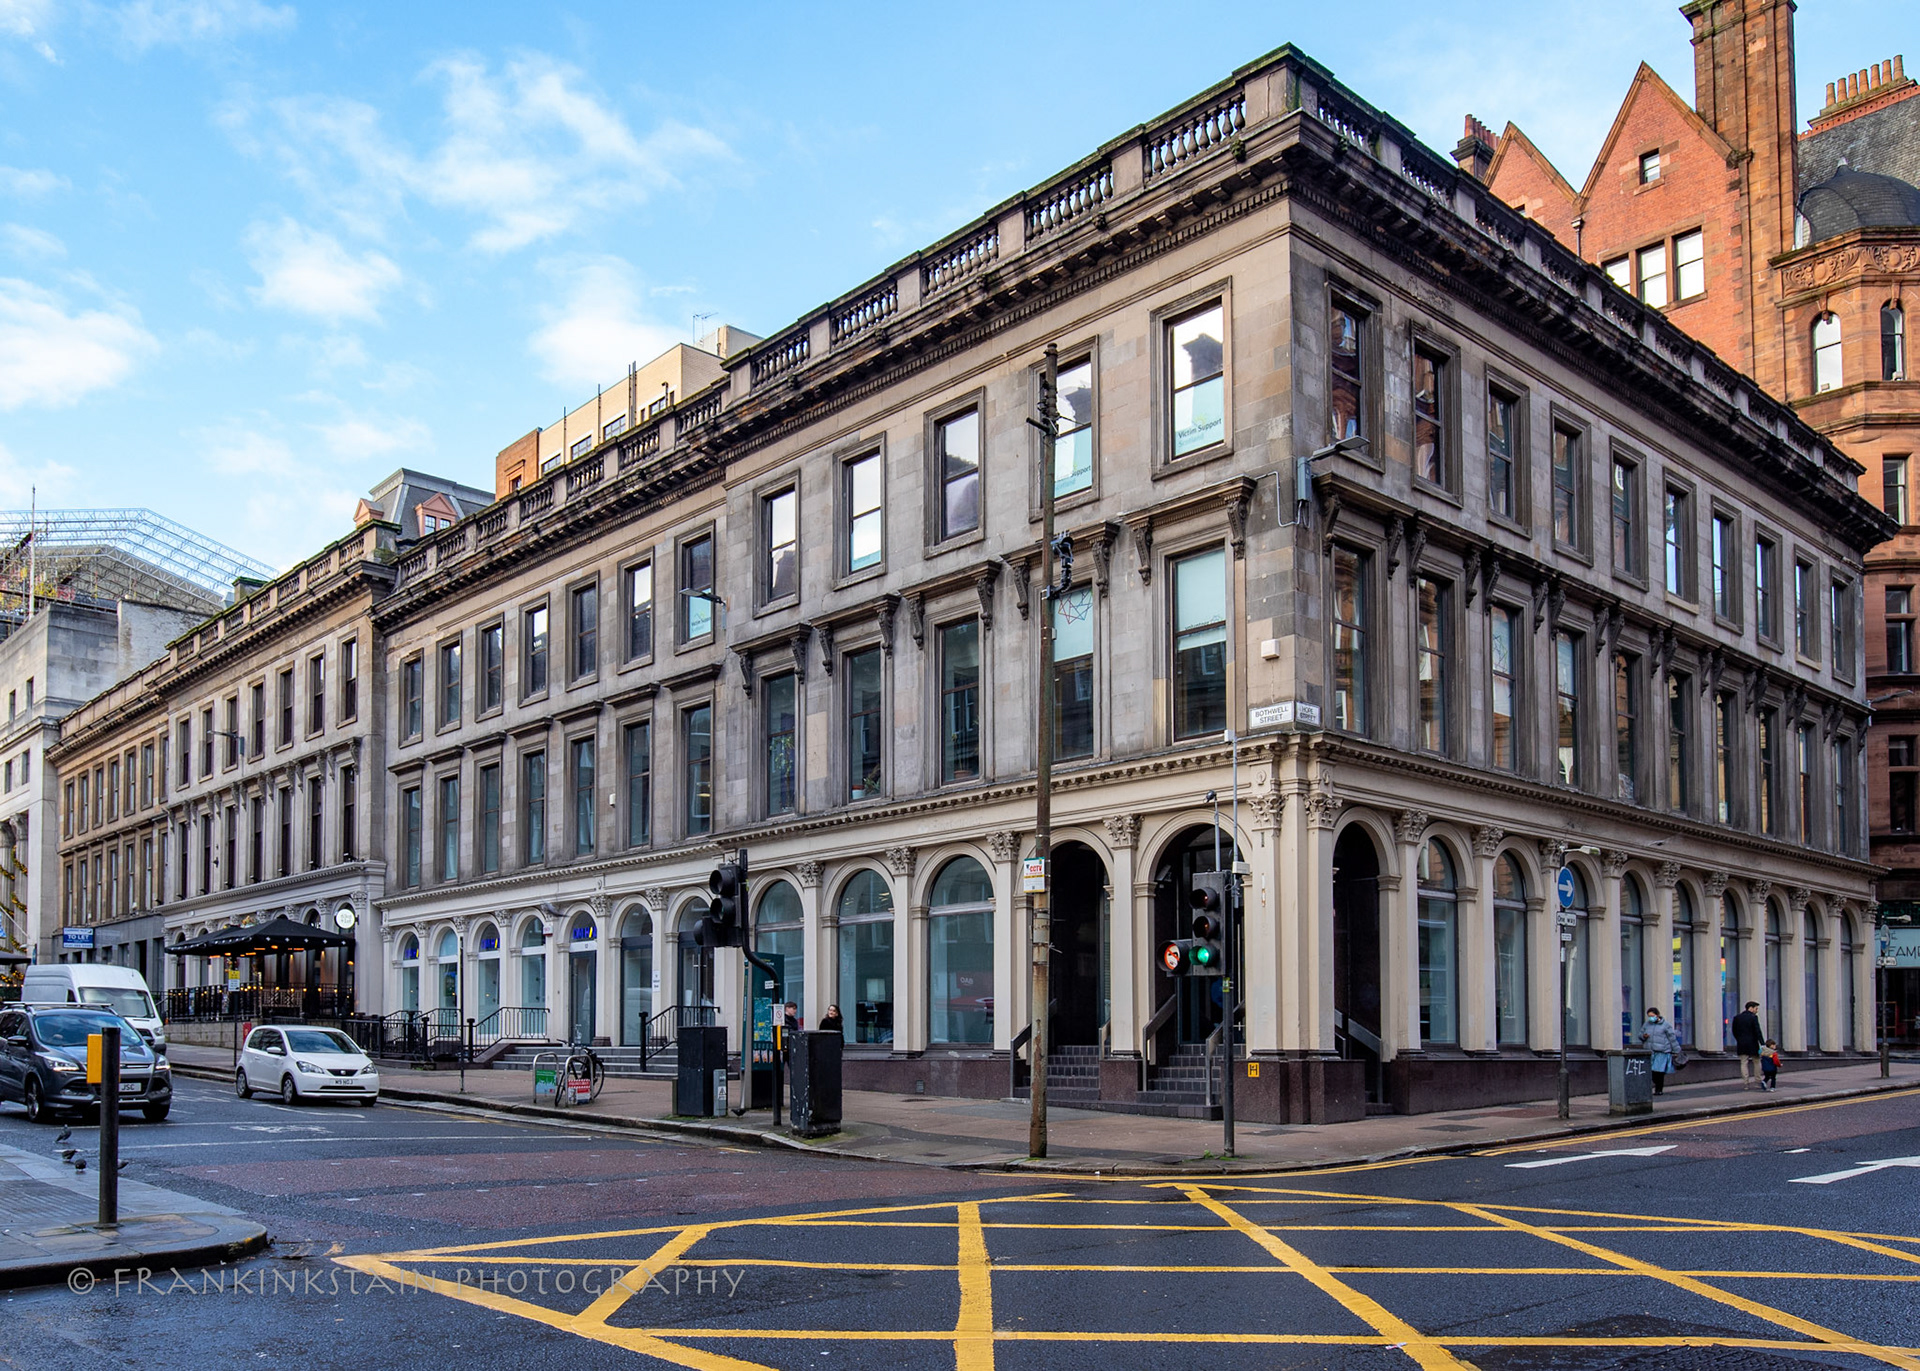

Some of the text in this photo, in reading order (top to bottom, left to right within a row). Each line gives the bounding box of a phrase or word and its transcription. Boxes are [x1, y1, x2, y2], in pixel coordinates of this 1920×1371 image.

[1178, 418, 1222, 439] Victim Support
[1255, 705, 1289, 718] BOTHWELL
[1301, 706, 1314, 715] HOPE
[1260, 713, 1283, 724] STREET
[1300, 712, 1316, 721] STREET
[1029, 864, 1042, 872] CCTV
